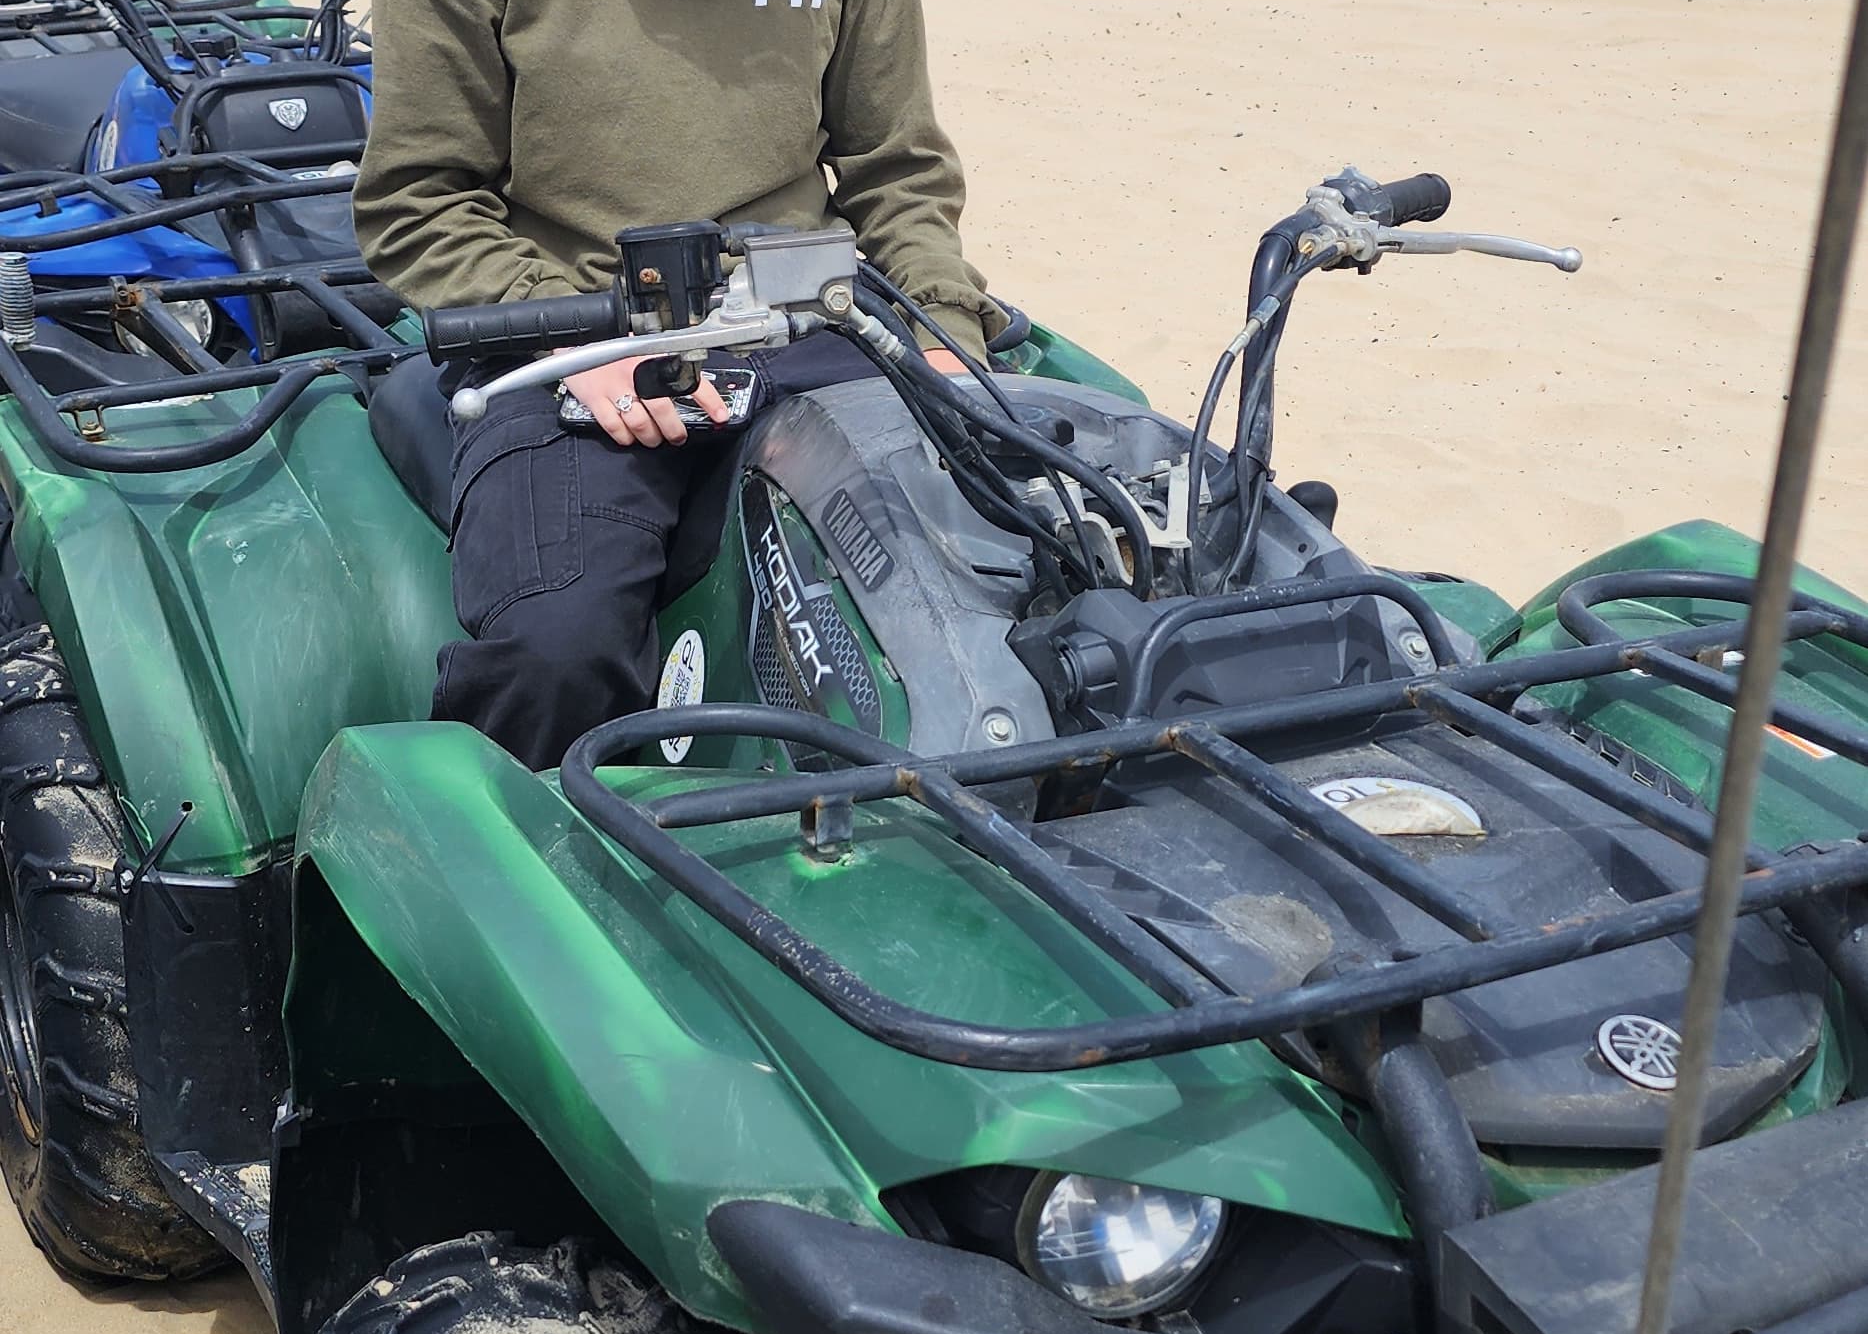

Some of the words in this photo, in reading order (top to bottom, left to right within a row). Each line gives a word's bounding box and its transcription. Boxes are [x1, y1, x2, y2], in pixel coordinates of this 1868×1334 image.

[753, 551, 773, 610] 450
[826, 493, 889, 587] YAMAHA
[761, 523, 834, 688] KODIAK
